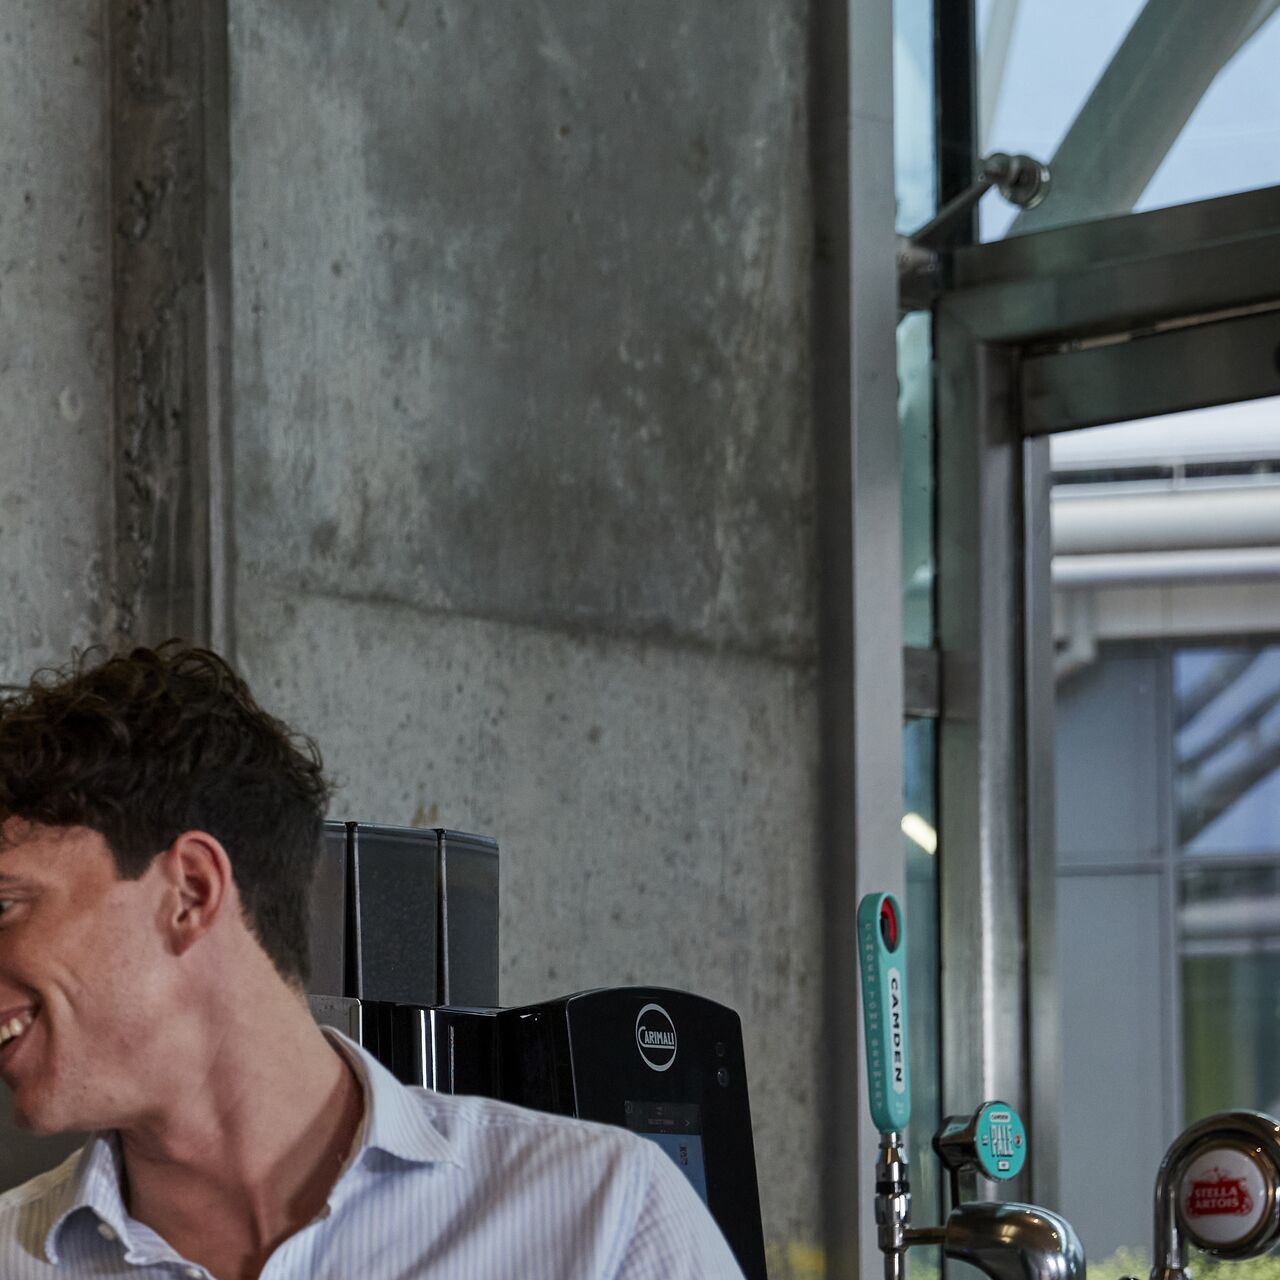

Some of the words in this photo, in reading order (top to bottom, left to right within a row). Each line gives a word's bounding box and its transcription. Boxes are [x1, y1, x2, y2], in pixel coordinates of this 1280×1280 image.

[638, 1026, 675, 1049] CARIMALI
[890, 977, 904, 1084] CAMDEN
[991, 1124, 1014, 1156] PALE
[1194, 1186, 1239, 1200] STELLA
[1195, 1197, 1240, 1210] ARTOIS
